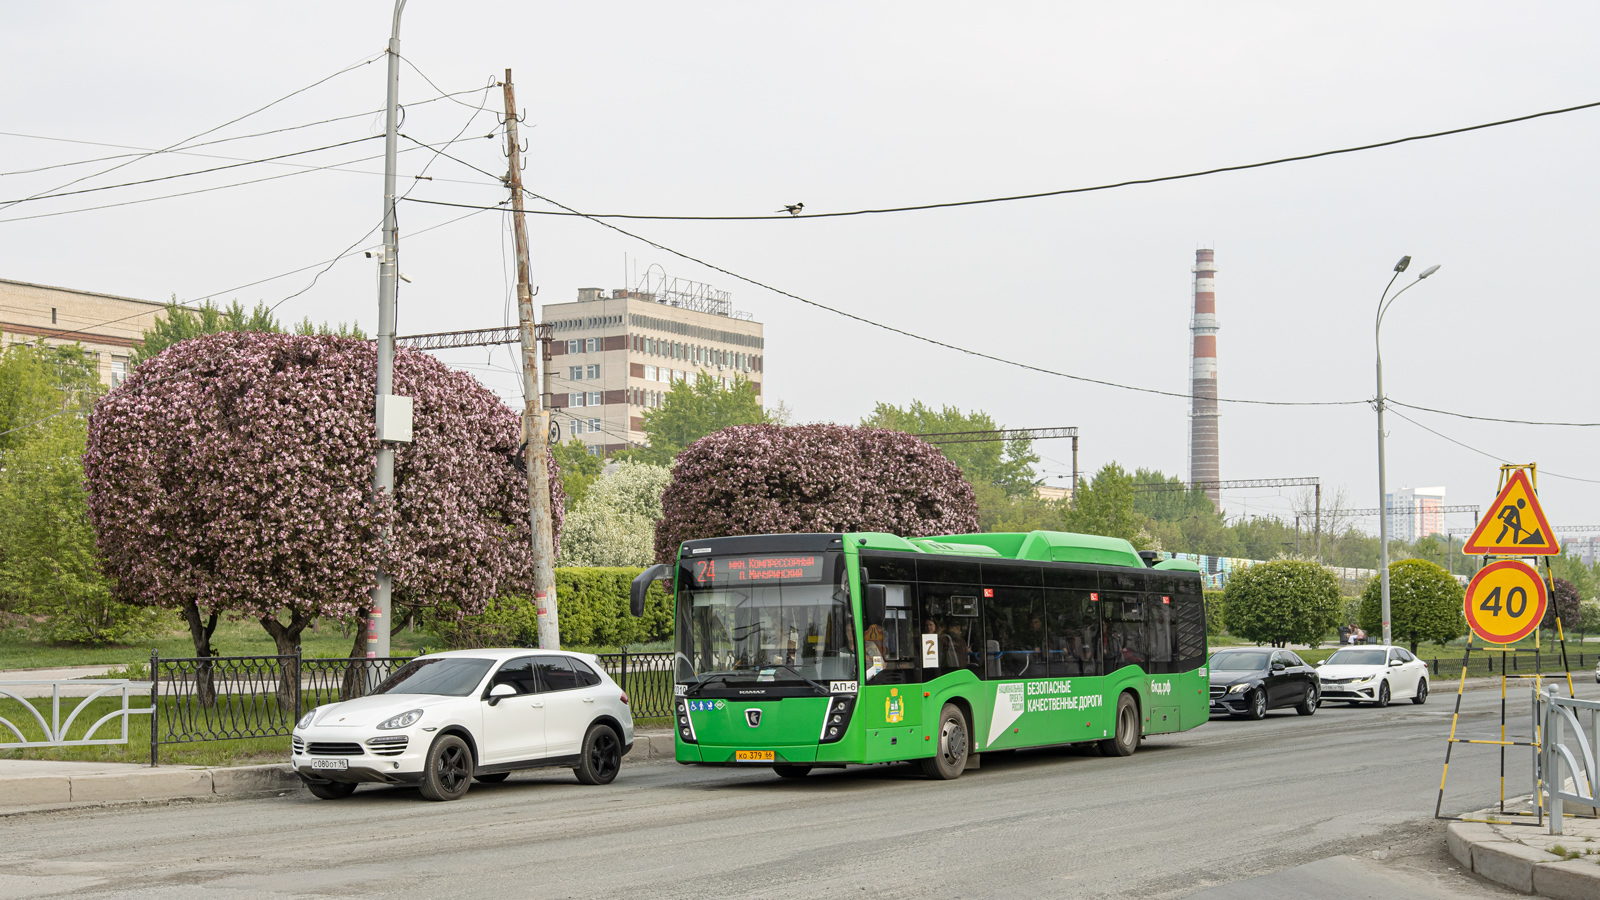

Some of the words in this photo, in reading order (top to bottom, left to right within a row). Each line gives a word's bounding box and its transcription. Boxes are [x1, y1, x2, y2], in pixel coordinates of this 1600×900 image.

[697, 560, 716, 582] 24
[1480, 586, 1527, 618] 40
[832, 683, 856, 691] АП-6
[1027, 680, 1071, 695] БЕЗОПАСНЫЕ
[1150, 679, 1171, 695] бкд.рф
[1027, 696, 1078, 712] КАЧЕСТВЕННЫЕ
[1078, 694, 1103, 711] ДОРОГИ
[750, 751, 762, 759] 379
